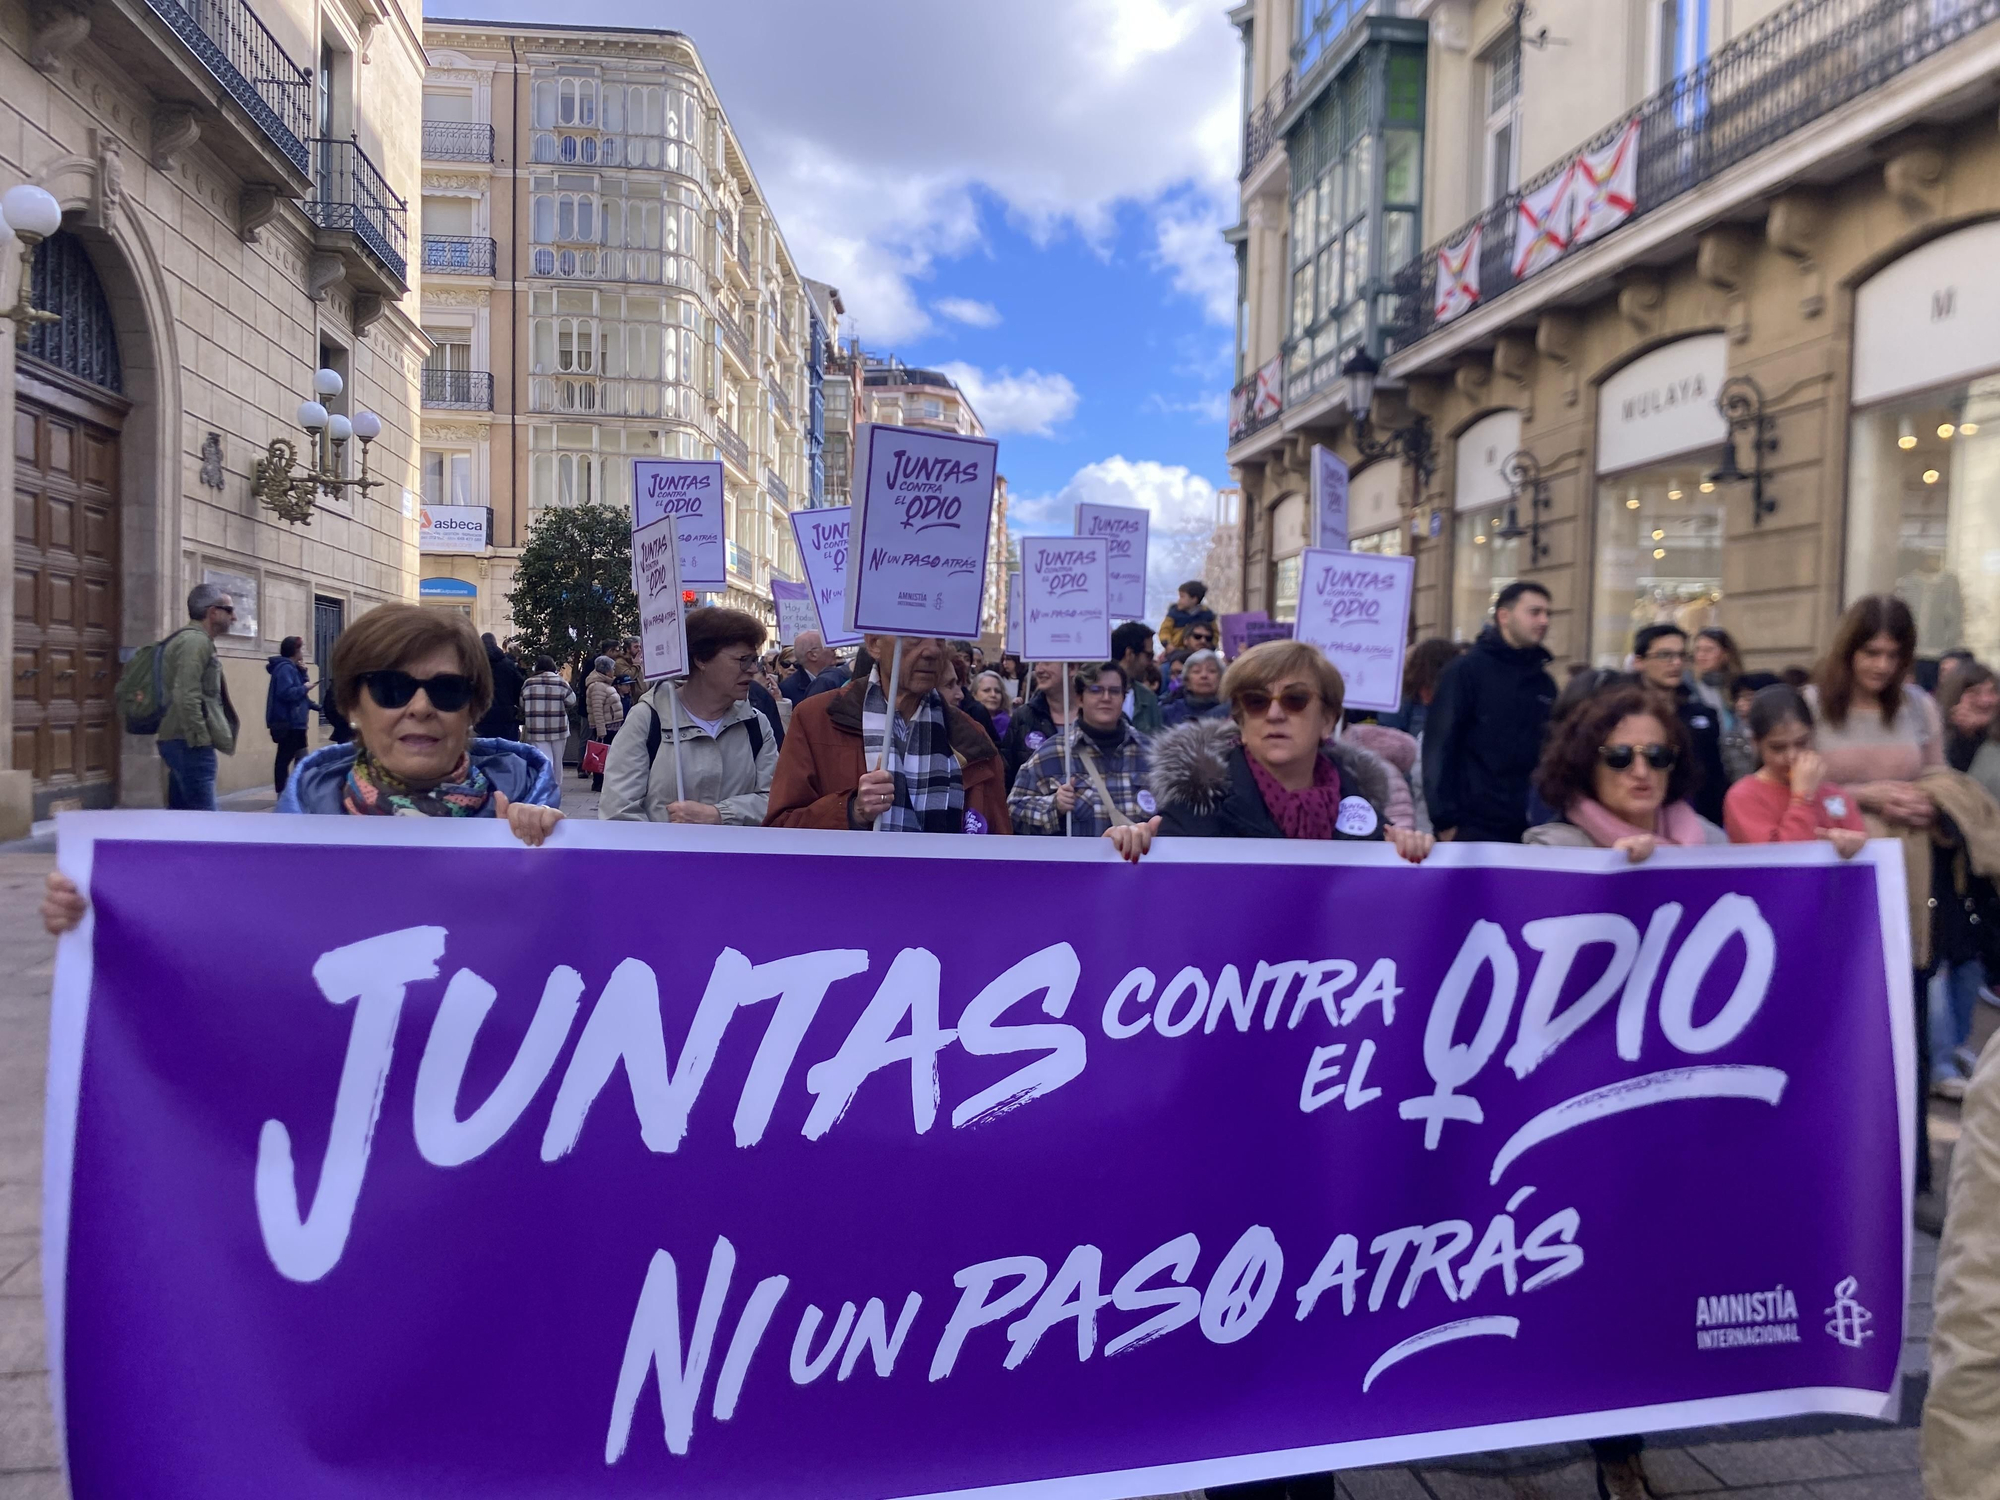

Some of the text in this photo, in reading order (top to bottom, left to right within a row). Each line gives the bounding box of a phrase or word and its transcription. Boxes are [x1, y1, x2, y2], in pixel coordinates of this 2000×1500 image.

[1621, 372, 1707, 423] MULAYA
[886, 450, 978, 490] JUNTAS
[648, 474, 711, 498] JUNTAS
[899, 481, 942, 494] CONTRA
[664, 497, 702, 514] ODIO
[894, 495, 962, 529] EL ODIO
[434, 518, 482, 531] asbeca
[812, 522, 850, 550] JUNT
[1088, 516, 1139, 535] JUNTAS
[640, 534, 668, 574] JUNTAS
[824, 541, 848, 549] CONT
[824, 551, 832, 559] EL
[1110, 540, 1131, 553] DIO
[869, 548, 977, 571] NI UN PASO ATRÁS
[1035, 549, 1097, 574] JUNTAS
[649, 564, 666, 596] ODIO
[1046, 572, 1088, 596] ODIO
[1316, 565, 1395, 596] JUNTAS
[784, 602, 800, 613] Hoy
[821, 587, 832, 604] NI
[898, 591, 927, 602] AMNISTÍA
[782, 614, 794, 622] por
[1328, 599, 1380, 623] ODIO
[794, 622, 807, 630] que
[255, 892, 1777, 1284] JUNTAS CONTRA EL ODIO
[1695, 1284, 1799, 1328] AMNISTÍA
[605, 1185, 1585, 1465] NI UN PASO ATRÁS
[1696, 1323, 1801, 1350] INTERNACIONAL
